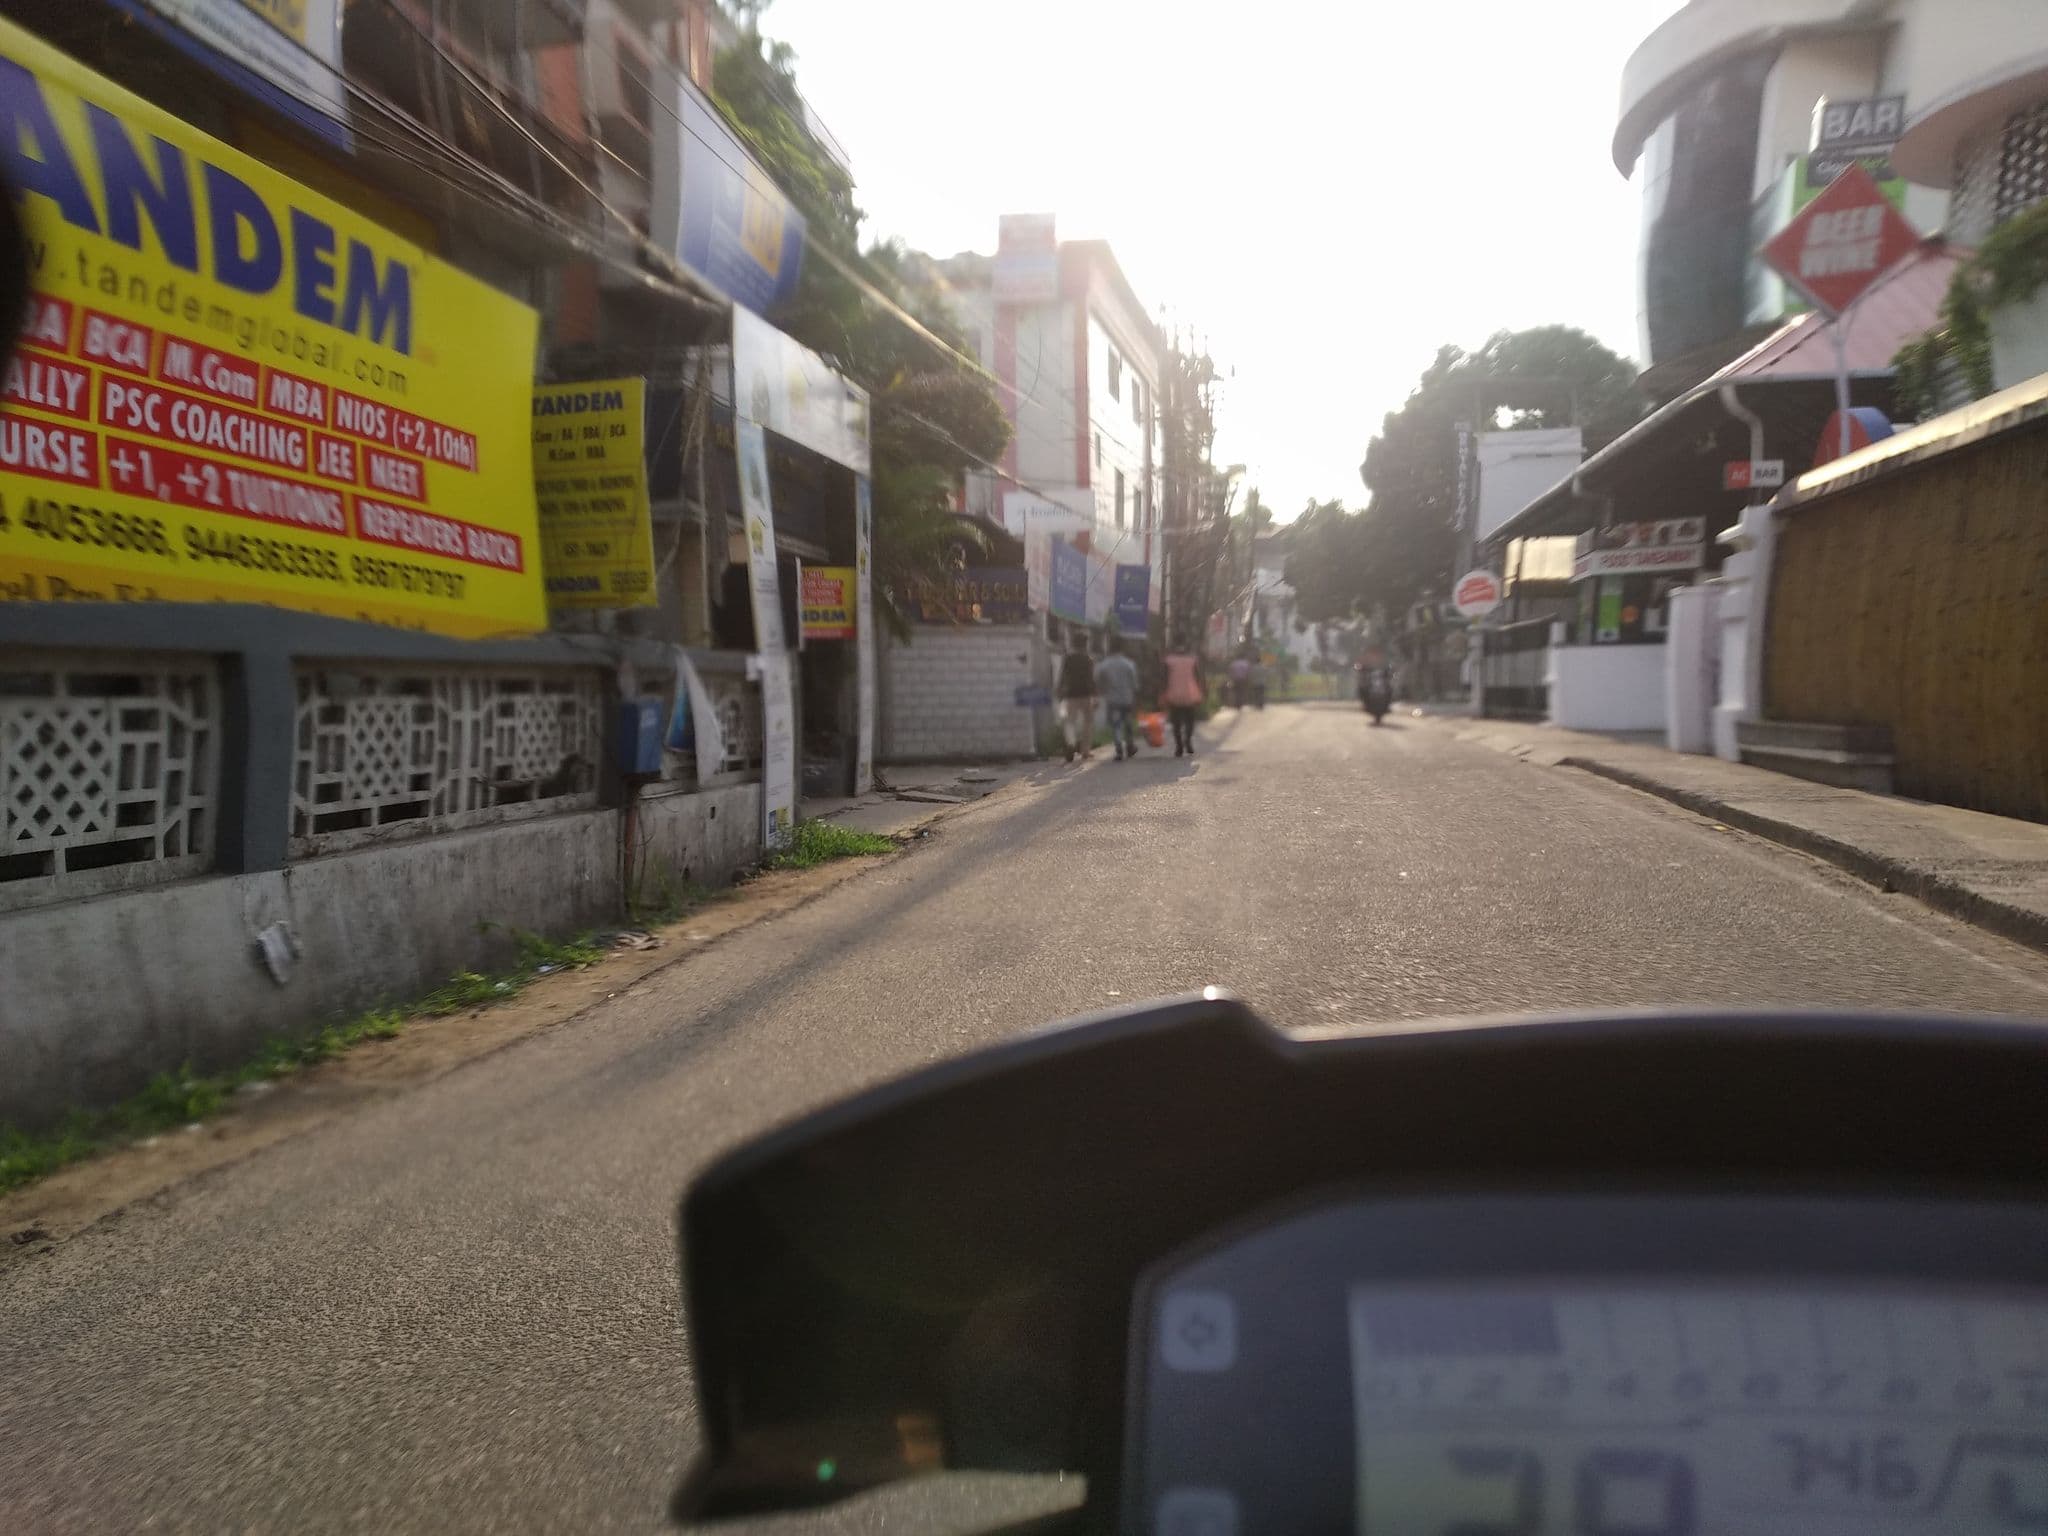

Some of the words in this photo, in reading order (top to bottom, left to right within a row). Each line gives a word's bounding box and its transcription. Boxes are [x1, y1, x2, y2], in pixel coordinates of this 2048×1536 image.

[1823, 101, 1899, 140] BAR
[0, 54, 412, 358] ANDEM
[2, 356, 86, 412] ALLY
[105, 380, 164, 433] PSC
[170, 399, 304, 467] COACHING
[316, 440, 357, 481] JEE
[368, 452, 420, 498] NEET
[84, 314, 148, 371] BCA
[163, 340, 258, 402] M.Com
[269, 373, 325, 422] MBA
[336, 395, 388, 441] NIOS
[392, 412, 477, 474] (+2,10th)
[109, 446, 171, 503] +1,
[176, 462, 224, 506] +2
[226, 469, 346, 533] TUITIONS
[357, 500, 464, 557] REPEATERS
[466, 525, 521, 569] BATCH
